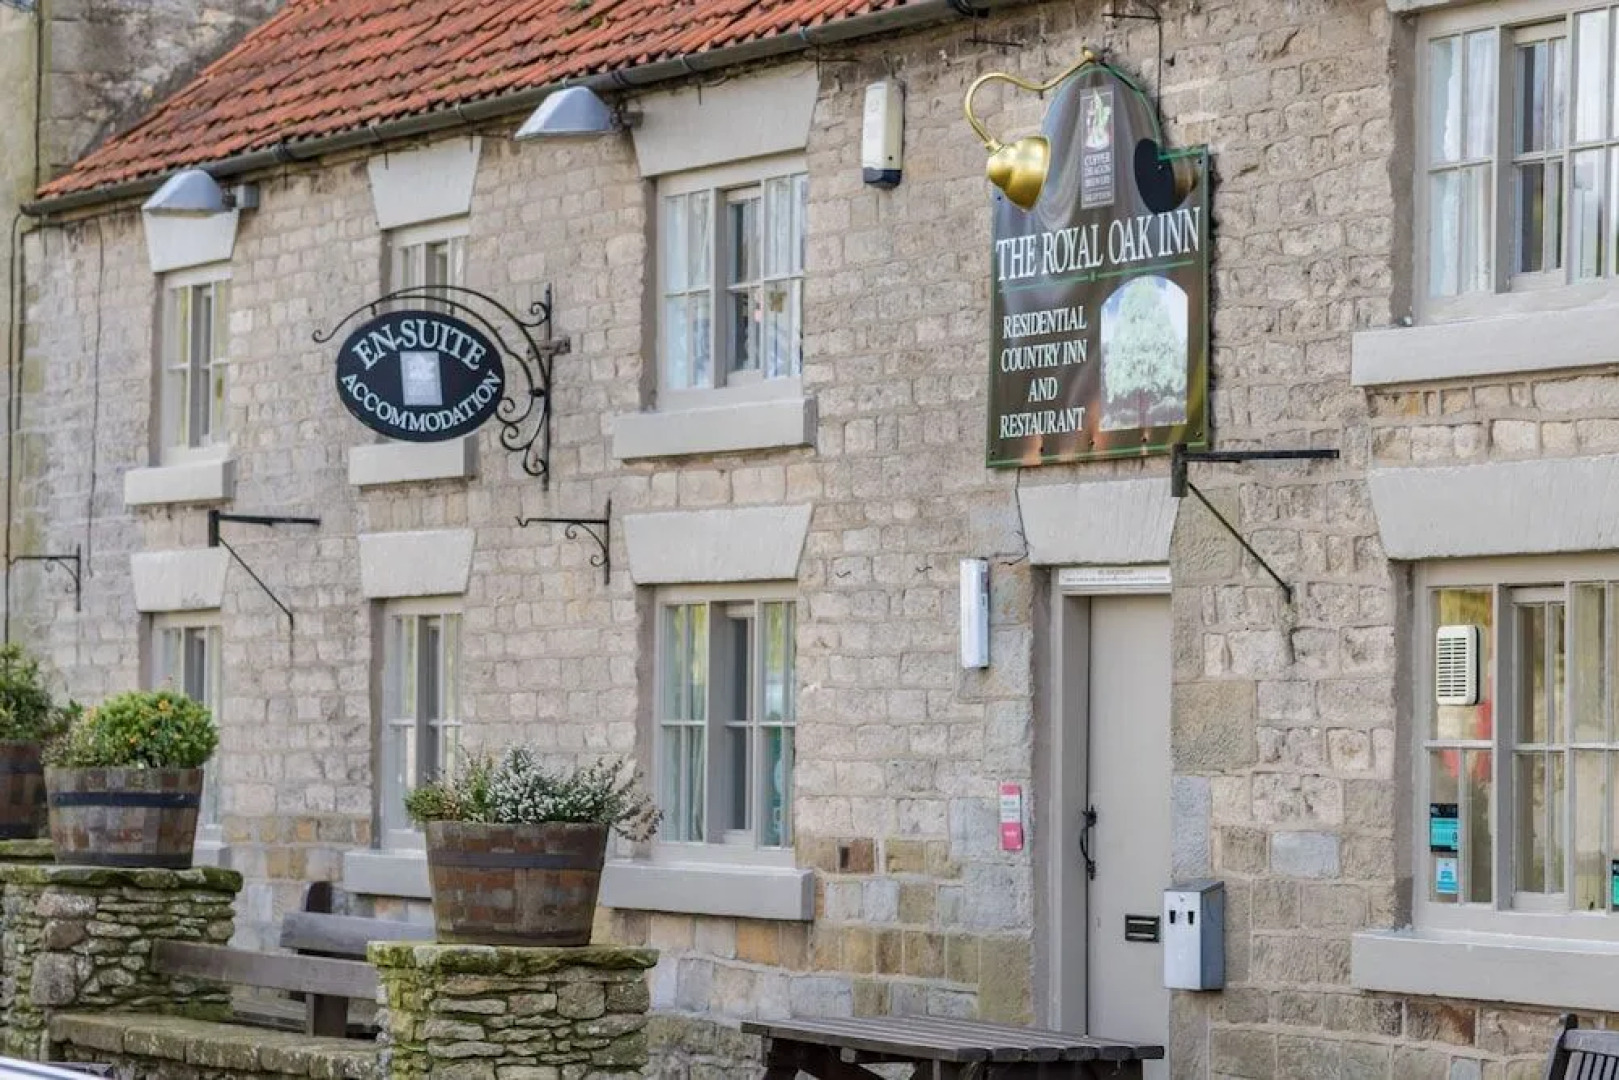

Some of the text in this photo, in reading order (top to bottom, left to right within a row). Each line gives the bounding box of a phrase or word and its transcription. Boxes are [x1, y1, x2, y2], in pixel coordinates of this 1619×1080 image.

[996, 206, 1200, 281] THE ROYAL OAK INN
[1003, 306, 1088, 339] RESIDENTIAL
[352, 318, 486, 371] EN-SUITE
[1001, 339, 1087, 372] COUNTRY INN
[341, 368, 501, 432] ACCOMMODATION
[1028, 377, 1058, 402] AND
[1000, 407, 1086, 439] RESTAURANT
